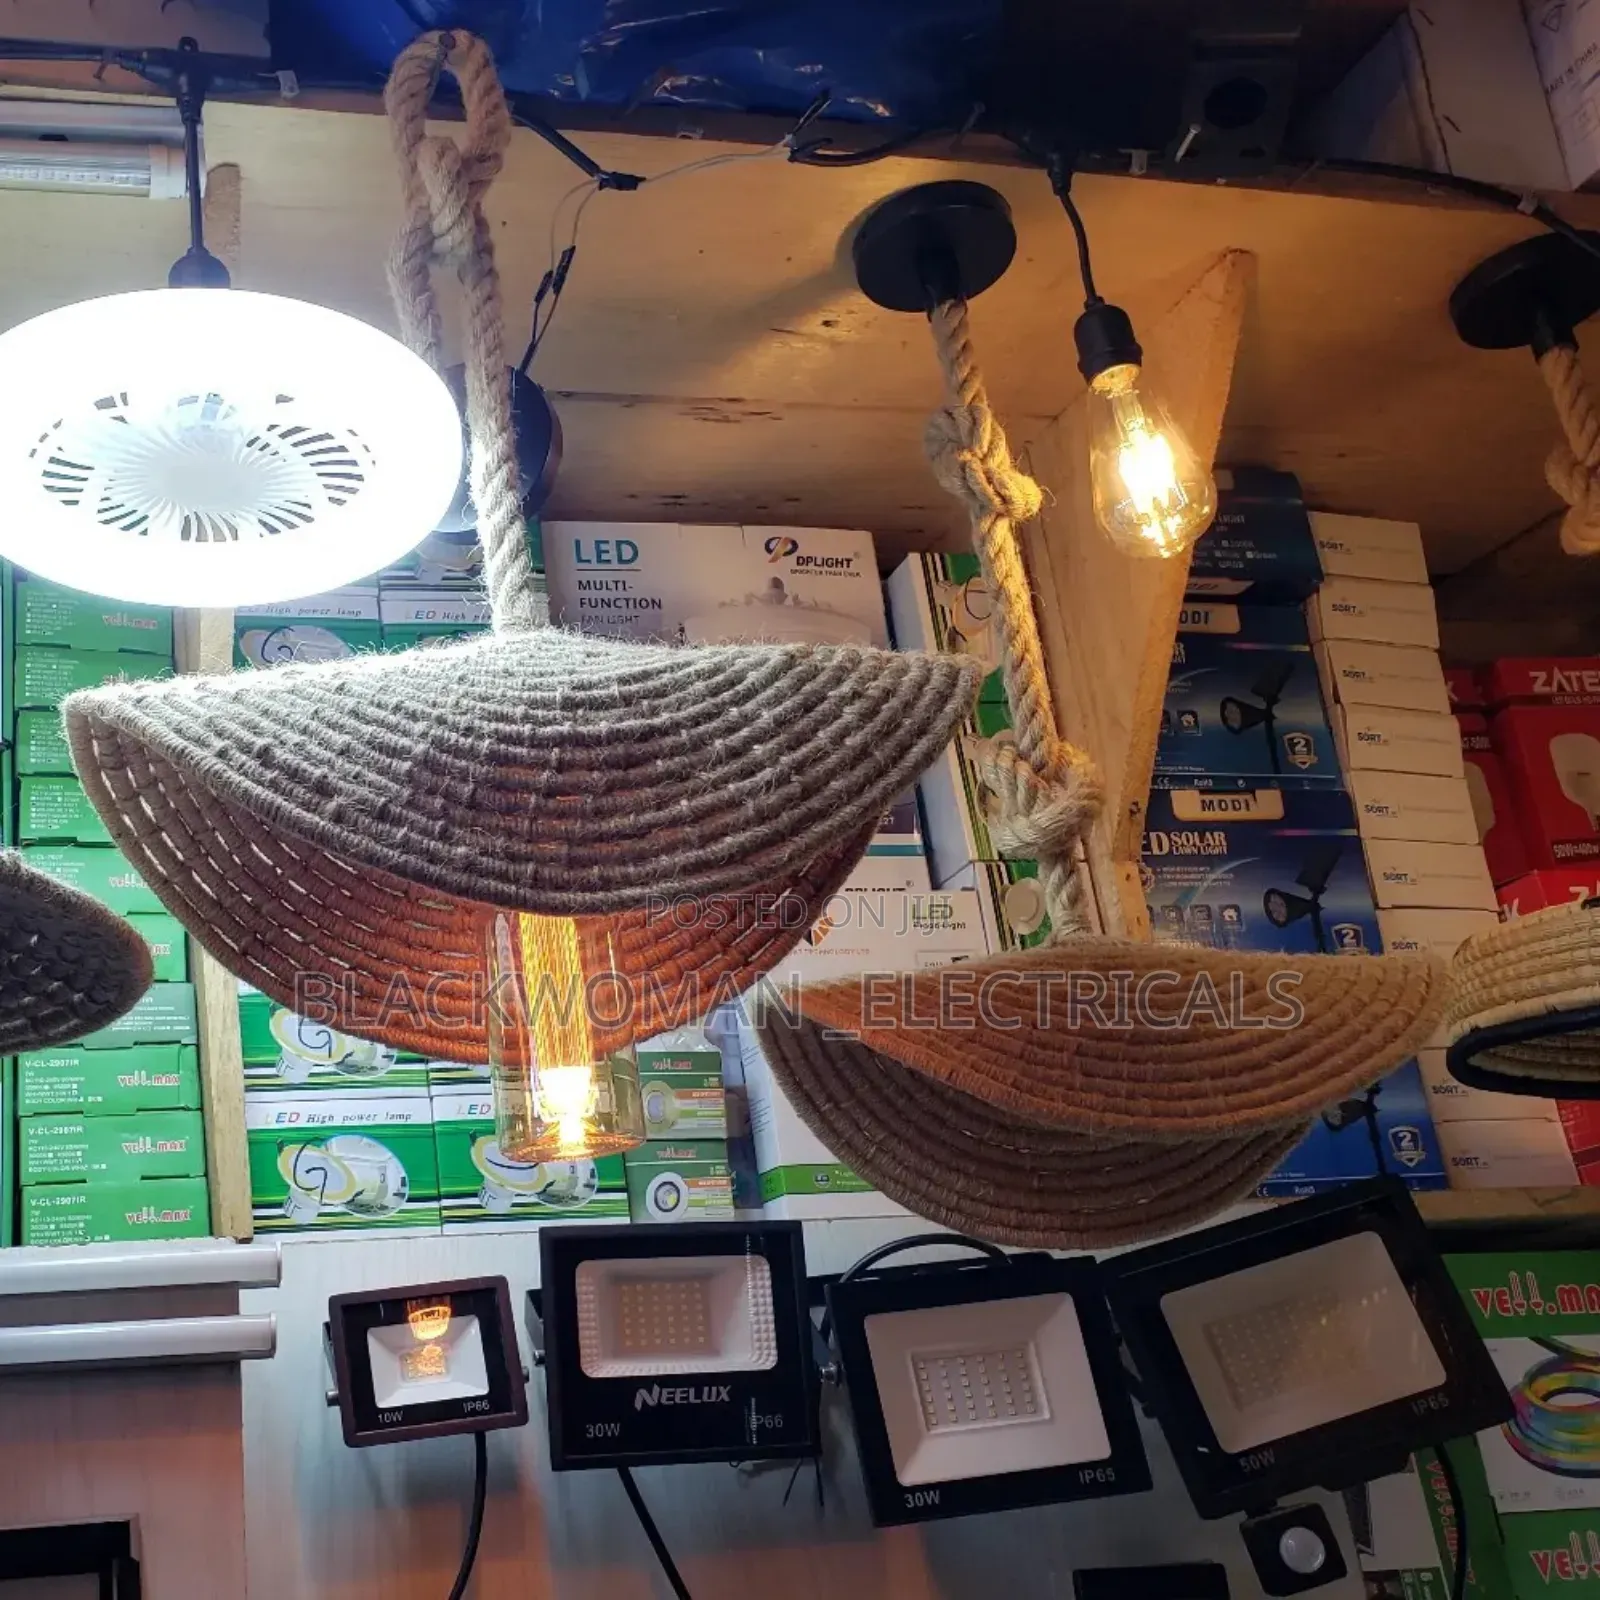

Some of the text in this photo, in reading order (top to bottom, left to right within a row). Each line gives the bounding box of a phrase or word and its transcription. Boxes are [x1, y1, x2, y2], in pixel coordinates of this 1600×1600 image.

[574, 538, 639, 564] LED
[796, 556, 853, 568] DPLIGHT
[578, 580, 633, 591] MULTI-
[579, 597, 662, 610] FUNCTION
[1332, 604, 1357, 613] SORT
[298, 608, 331, 616] power
[337, 607, 362, 617] lamp
[442, 612, 466, 621] High
[1180, 610, 1210, 624] ODI
[607, 615, 640, 624] LIGHT
[1529, 667, 1600, 693] ZATE
[1357, 732, 1382, 742] SORT
[1294, 738, 1307, 752] 2
[1201, 800, 1251, 812] MODI
[1364, 804, 1390, 815] SORT
[1141, 831, 1227, 855] ED SOLAR
[1383, 871, 1408, 882] SORT
[1342, 929, 1356, 945] 2
[1392, 940, 1418, 951] SORT
[1432, 1085, 1459, 1095] SORT
[457, 1104, 491, 1115] LED
[265, 1111, 412, 1124] LED High power lamp
[1398, 1131, 1413, 1147] 2
[1451, 1156, 1479, 1166] SORT
[634, 1384, 732, 1411] NEELUX
[378, 1400, 490, 1423] 10W IP66
[585, 1423, 621, 1438] 30W
[1240, 1449, 1276, 1472] 50W
[904, 1467, 1115, 1508] 30W IP65
